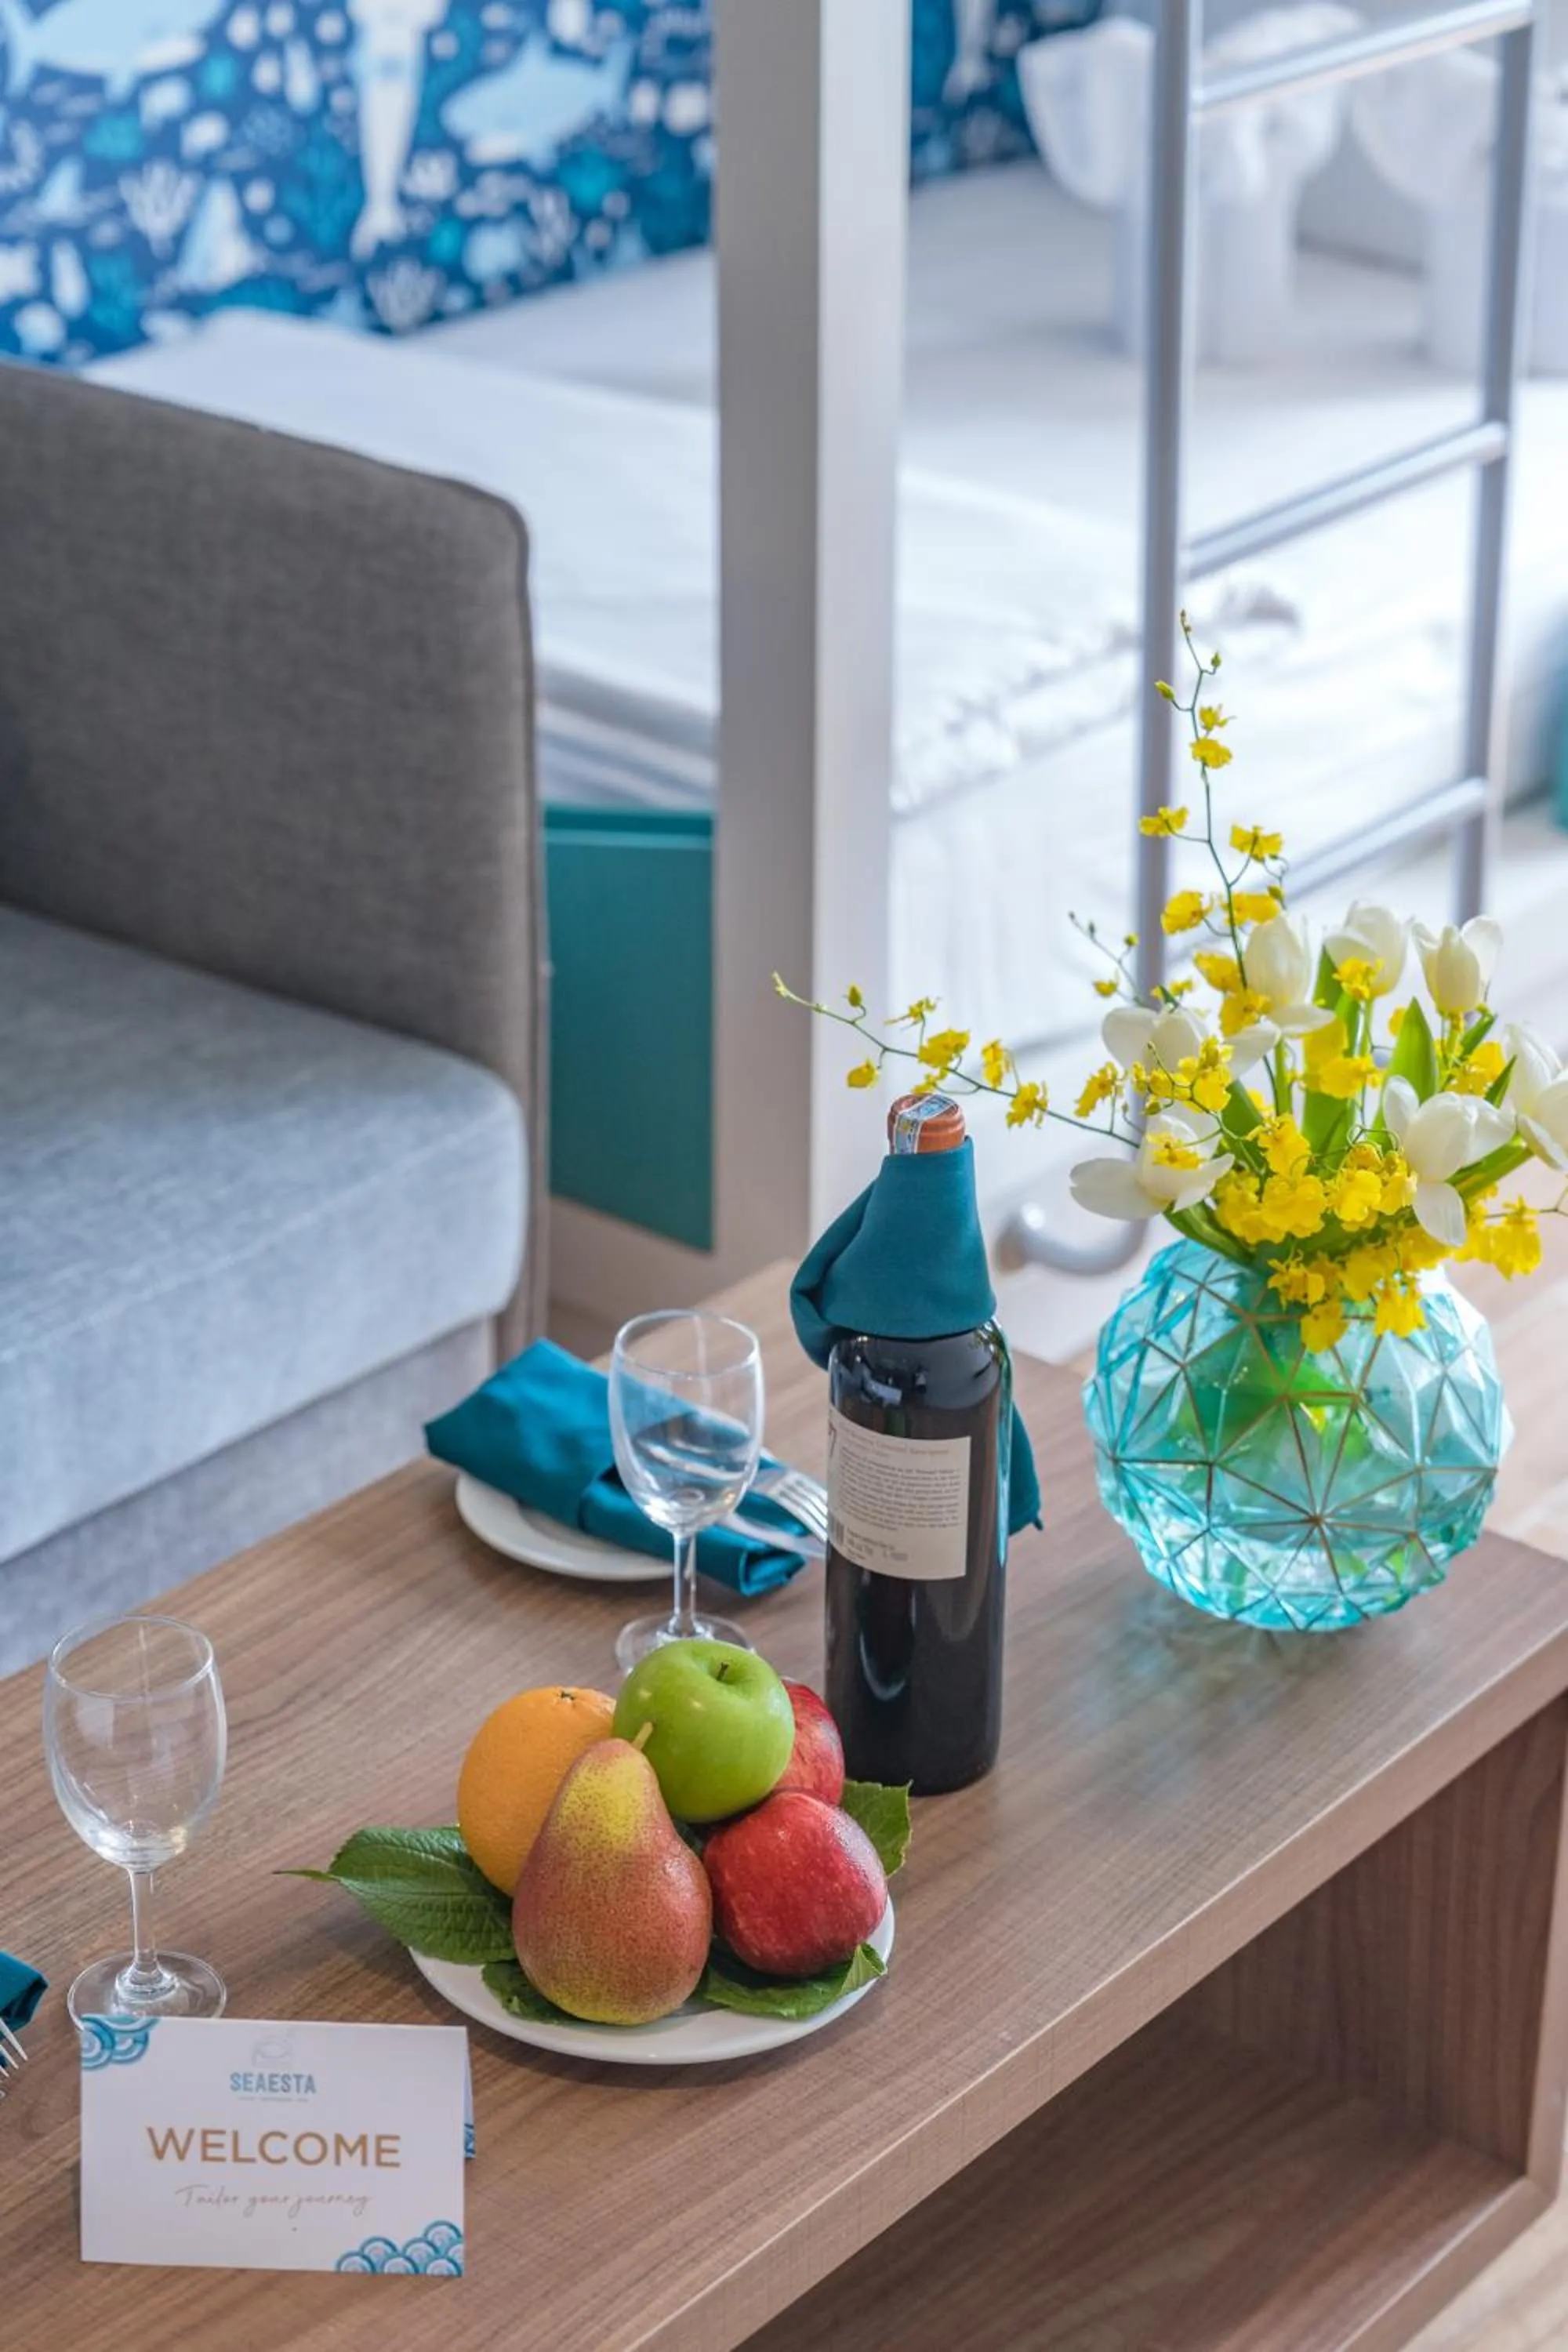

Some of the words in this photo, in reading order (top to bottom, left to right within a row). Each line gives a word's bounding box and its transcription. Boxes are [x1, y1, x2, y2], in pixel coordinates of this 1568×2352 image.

[229, 2071, 317, 2094] SEAESTA
[147, 2127, 401, 2168] WELCOME
[174, 2183, 239, 2208] Tailor
[242, 2194, 289, 2218] your
[287, 2193, 372, 2219] journey
